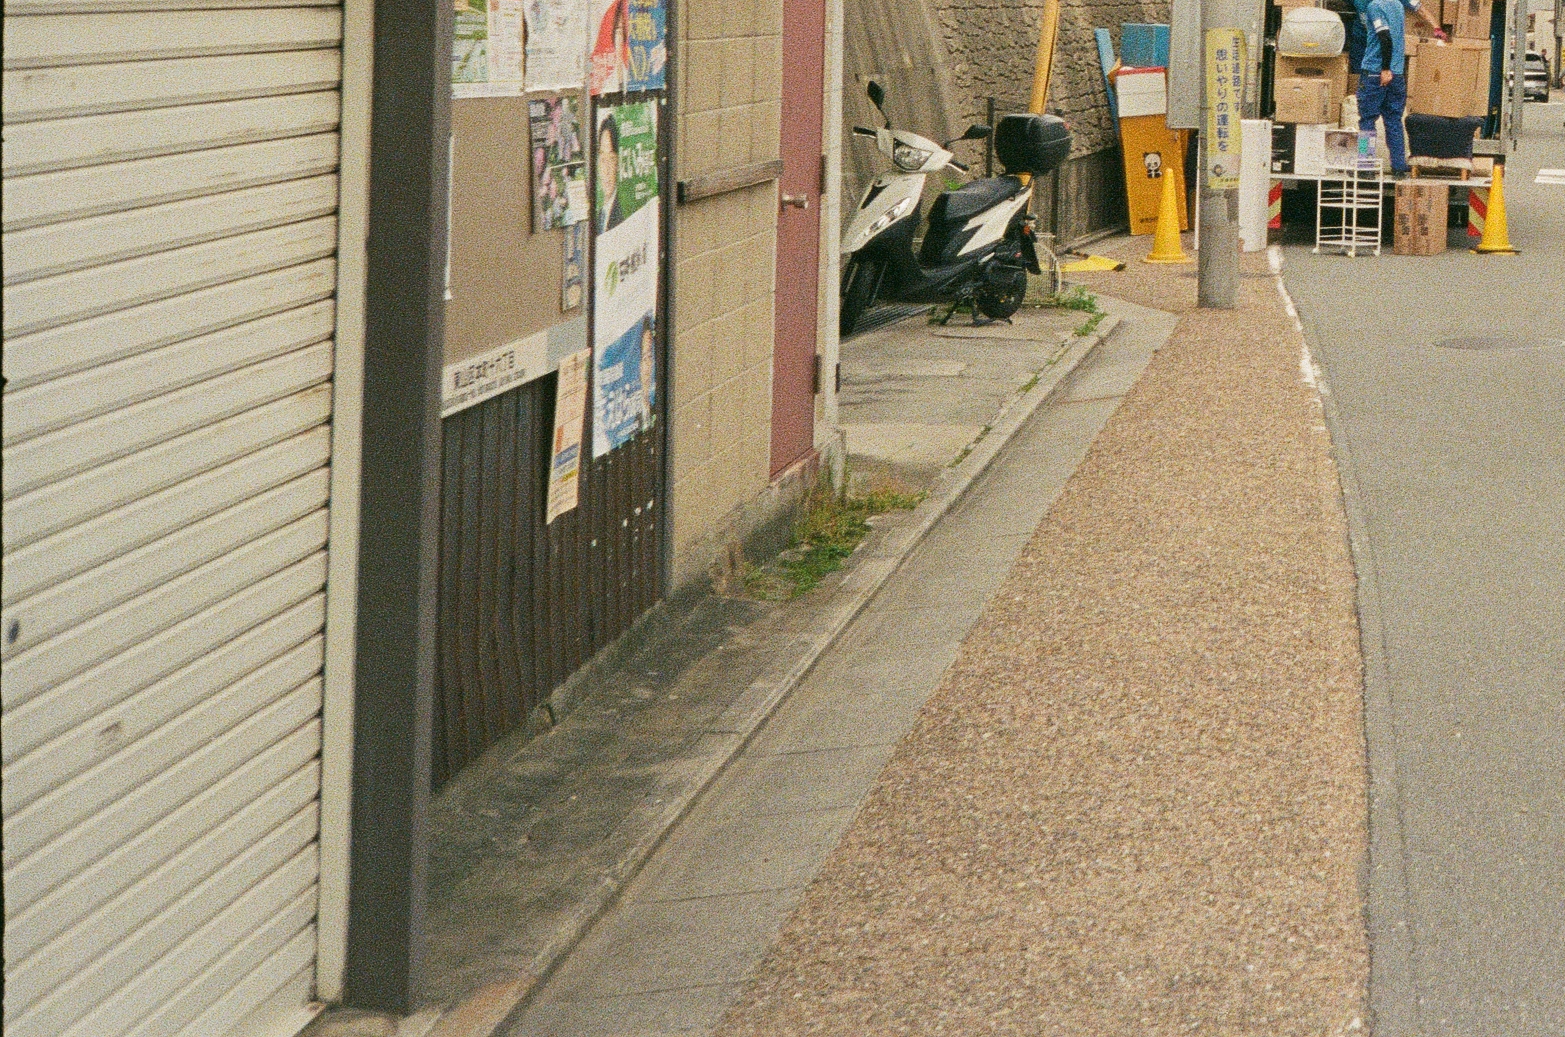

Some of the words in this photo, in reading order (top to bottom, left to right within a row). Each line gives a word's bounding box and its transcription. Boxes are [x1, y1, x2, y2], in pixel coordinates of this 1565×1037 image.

[1215, 48, 1229, 152] 思いやりの運転を
